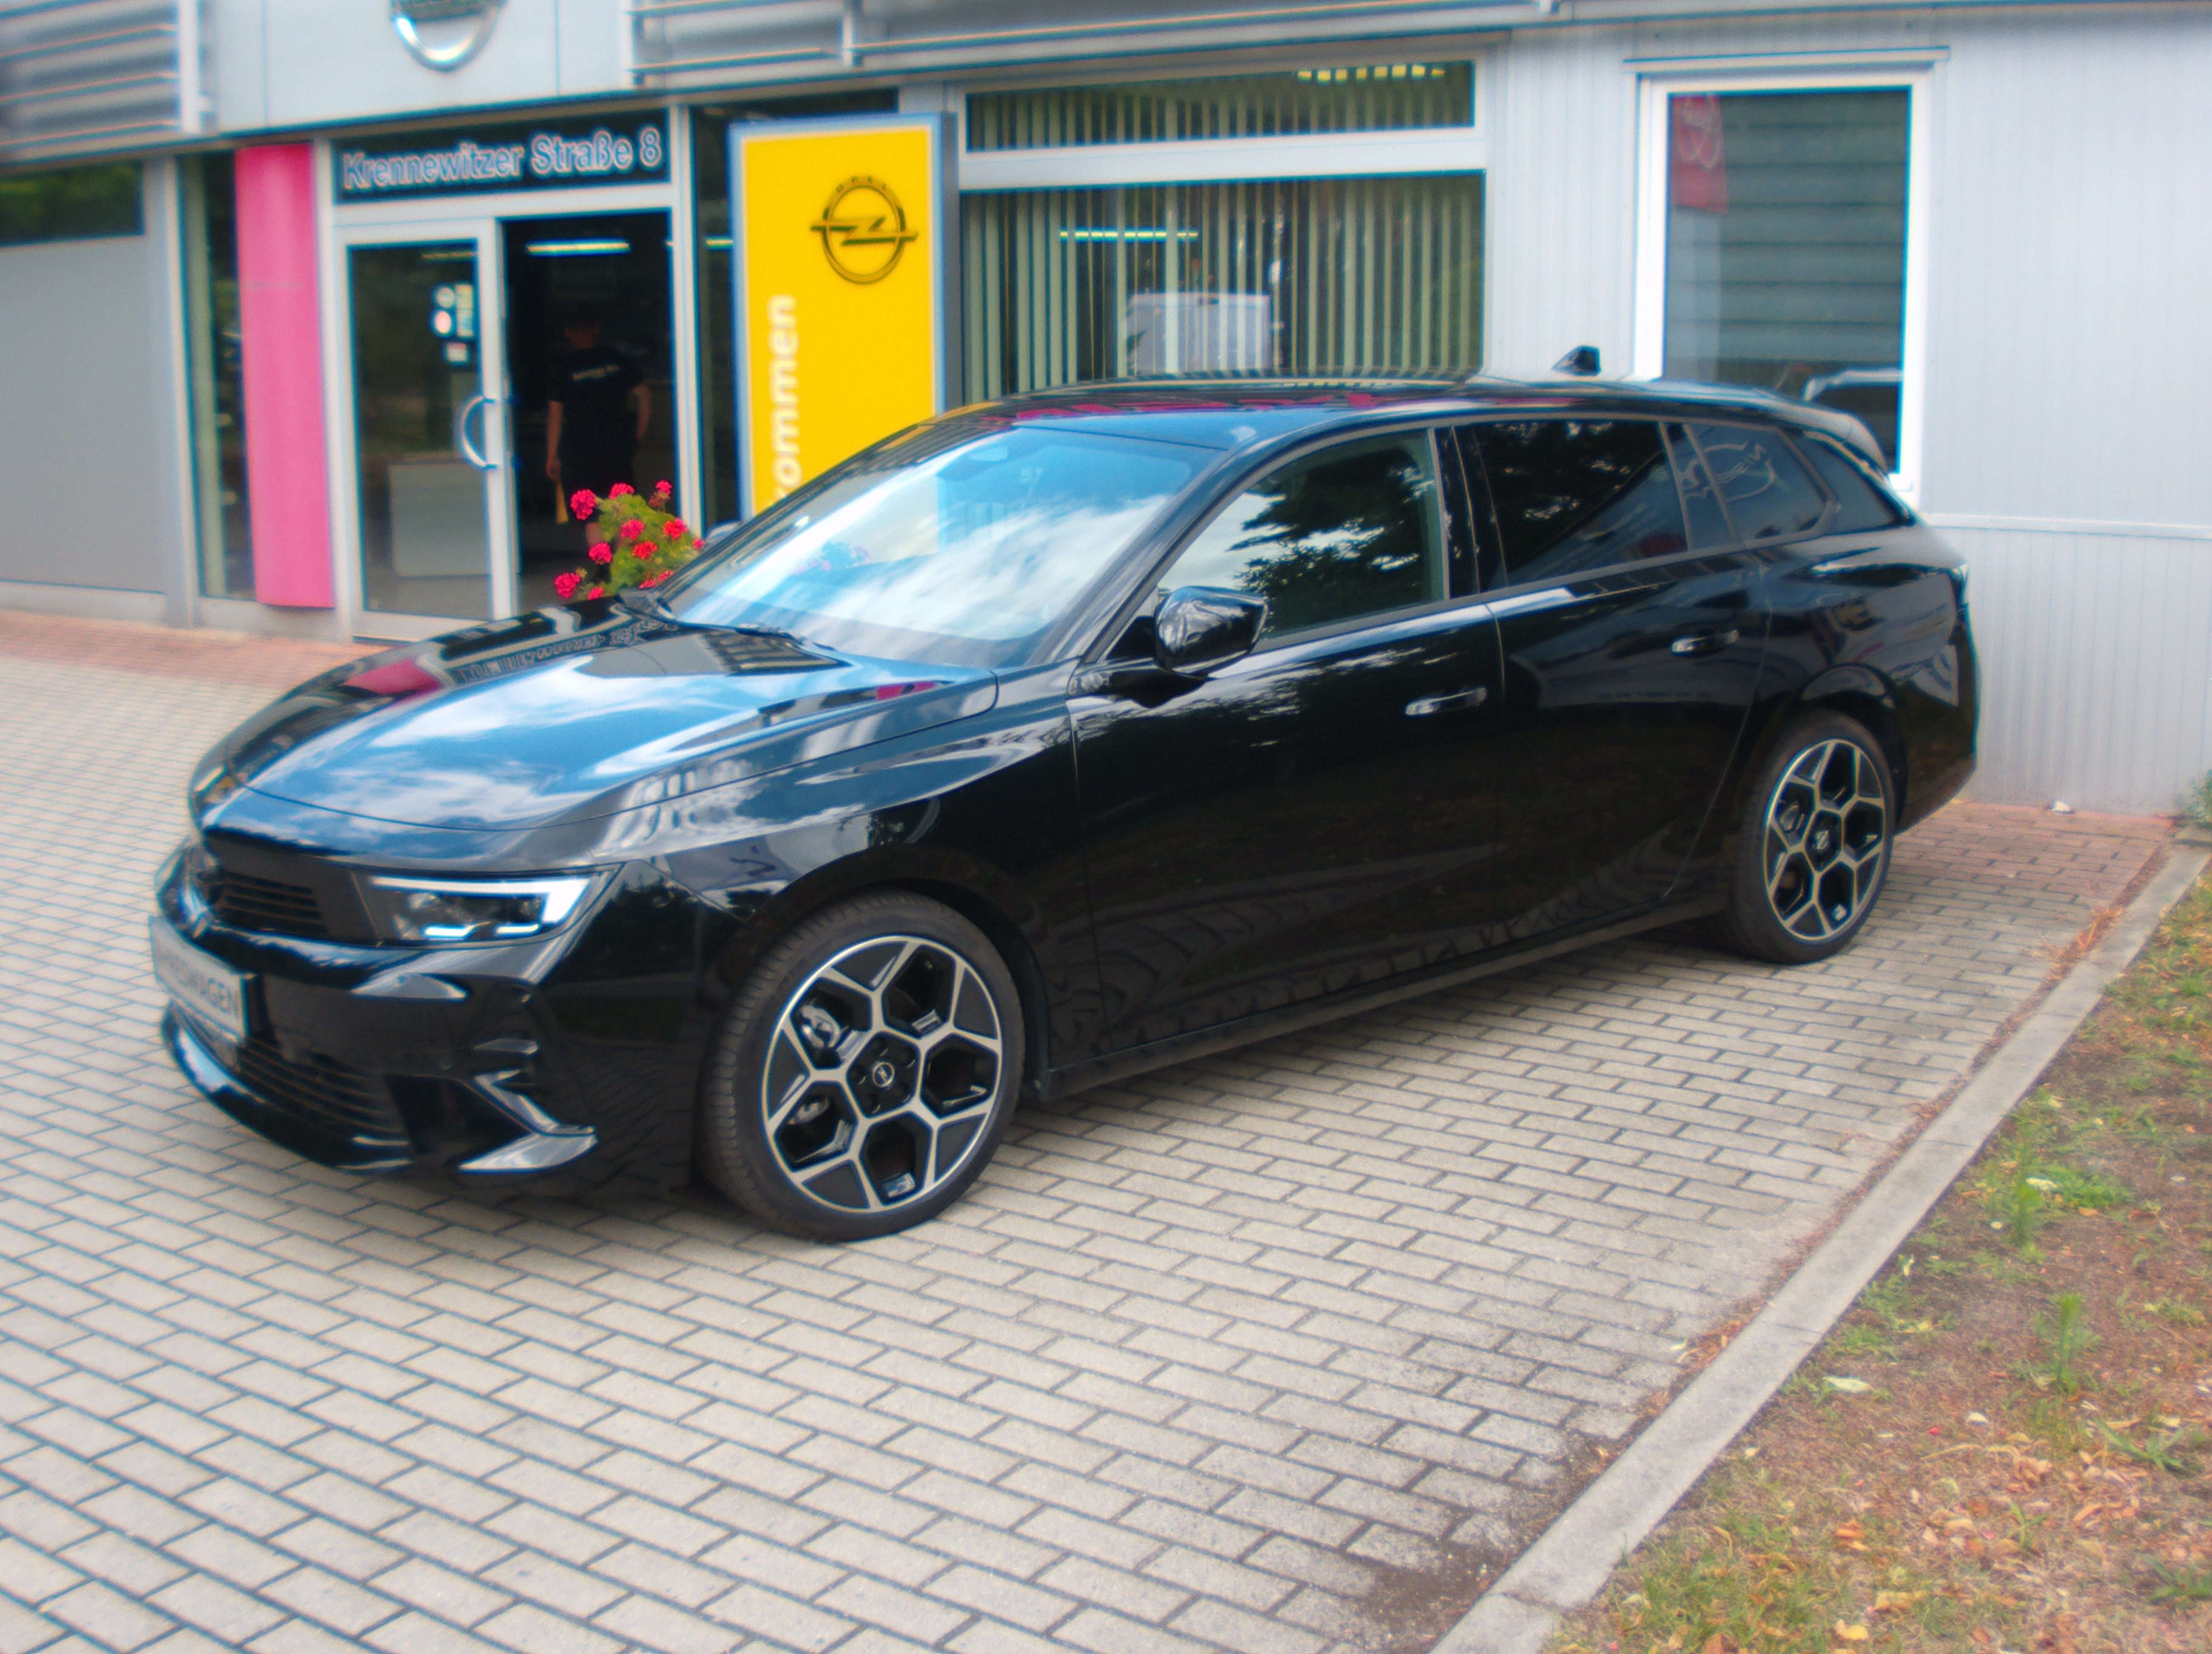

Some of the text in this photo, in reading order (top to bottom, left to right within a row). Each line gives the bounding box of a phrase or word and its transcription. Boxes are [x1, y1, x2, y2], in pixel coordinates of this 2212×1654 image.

[343, 127, 661, 190] Krennewitzer Straße 8
[768, 294, 801, 499] ommen
